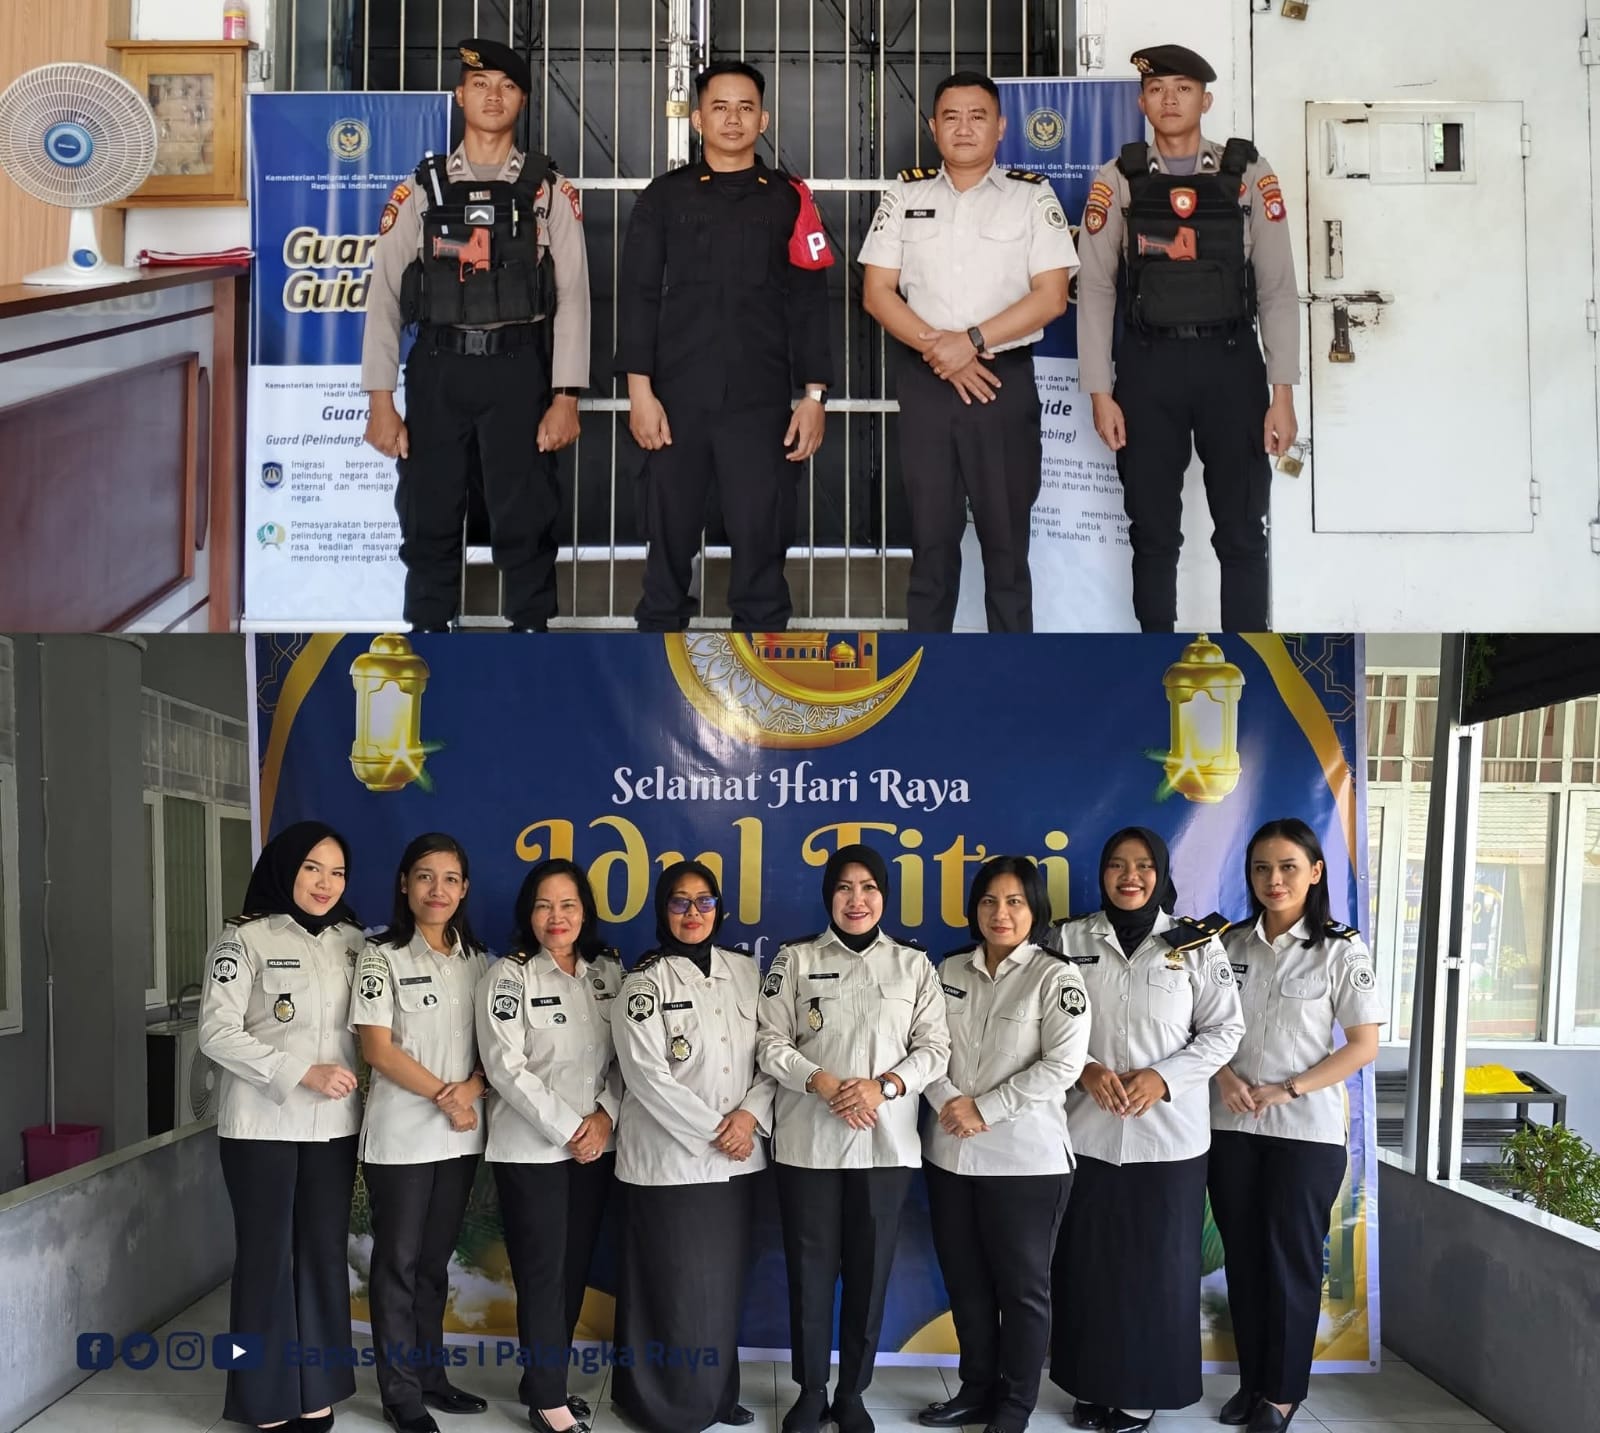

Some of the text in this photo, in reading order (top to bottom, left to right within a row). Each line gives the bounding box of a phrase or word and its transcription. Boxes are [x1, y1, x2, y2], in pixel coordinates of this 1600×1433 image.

[1065, 163, 1104, 171] Pemasyar
[369, 173, 411, 182] Pemasyar
[311, 182, 346, 190] Republik
[283, 226, 379, 269] Guar
[806, 232, 826, 261] P
[283, 270, 373, 313] Guid
[1048, 375, 1064, 383] dan
[1045, 383, 1069, 392] Untuk
[1040, 400, 1072, 417] ide
[265, 434, 299, 445] Guard
[1040, 428, 1076, 443] mbing)
[291, 461, 383, 471] Imigrasi berperan
[1042, 456, 1116, 471] mbimbing masya
[291, 471, 392, 481] pelindung negara dari
[1064, 471, 1092, 480] masuk
[358, 483, 393, 492] menjaga
[1042, 480, 1060, 489] tuhi
[1062, 482, 1090, 492] aturan
[291, 520, 361, 530] Pemasyarakatan
[1076, 521, 1101, 530] untuk
[1116, 525, 1129, 534] tid
[291, 531, 396, 541] pelindung negara dalam
[1047, 529, 1091, 543] kesalahan
[1099, 535, 1107, 543] di
[318, 543, 353, 551] keadilan
[362, 543, 400, 552] masyara
[291, 555, 339, 564] mendorong
[341, 554, 387, 564] reintegrasi
[611, 760, 971, 812] Selamat Hari Raya
[515, 815, 1070, 928] Idl Fiti
